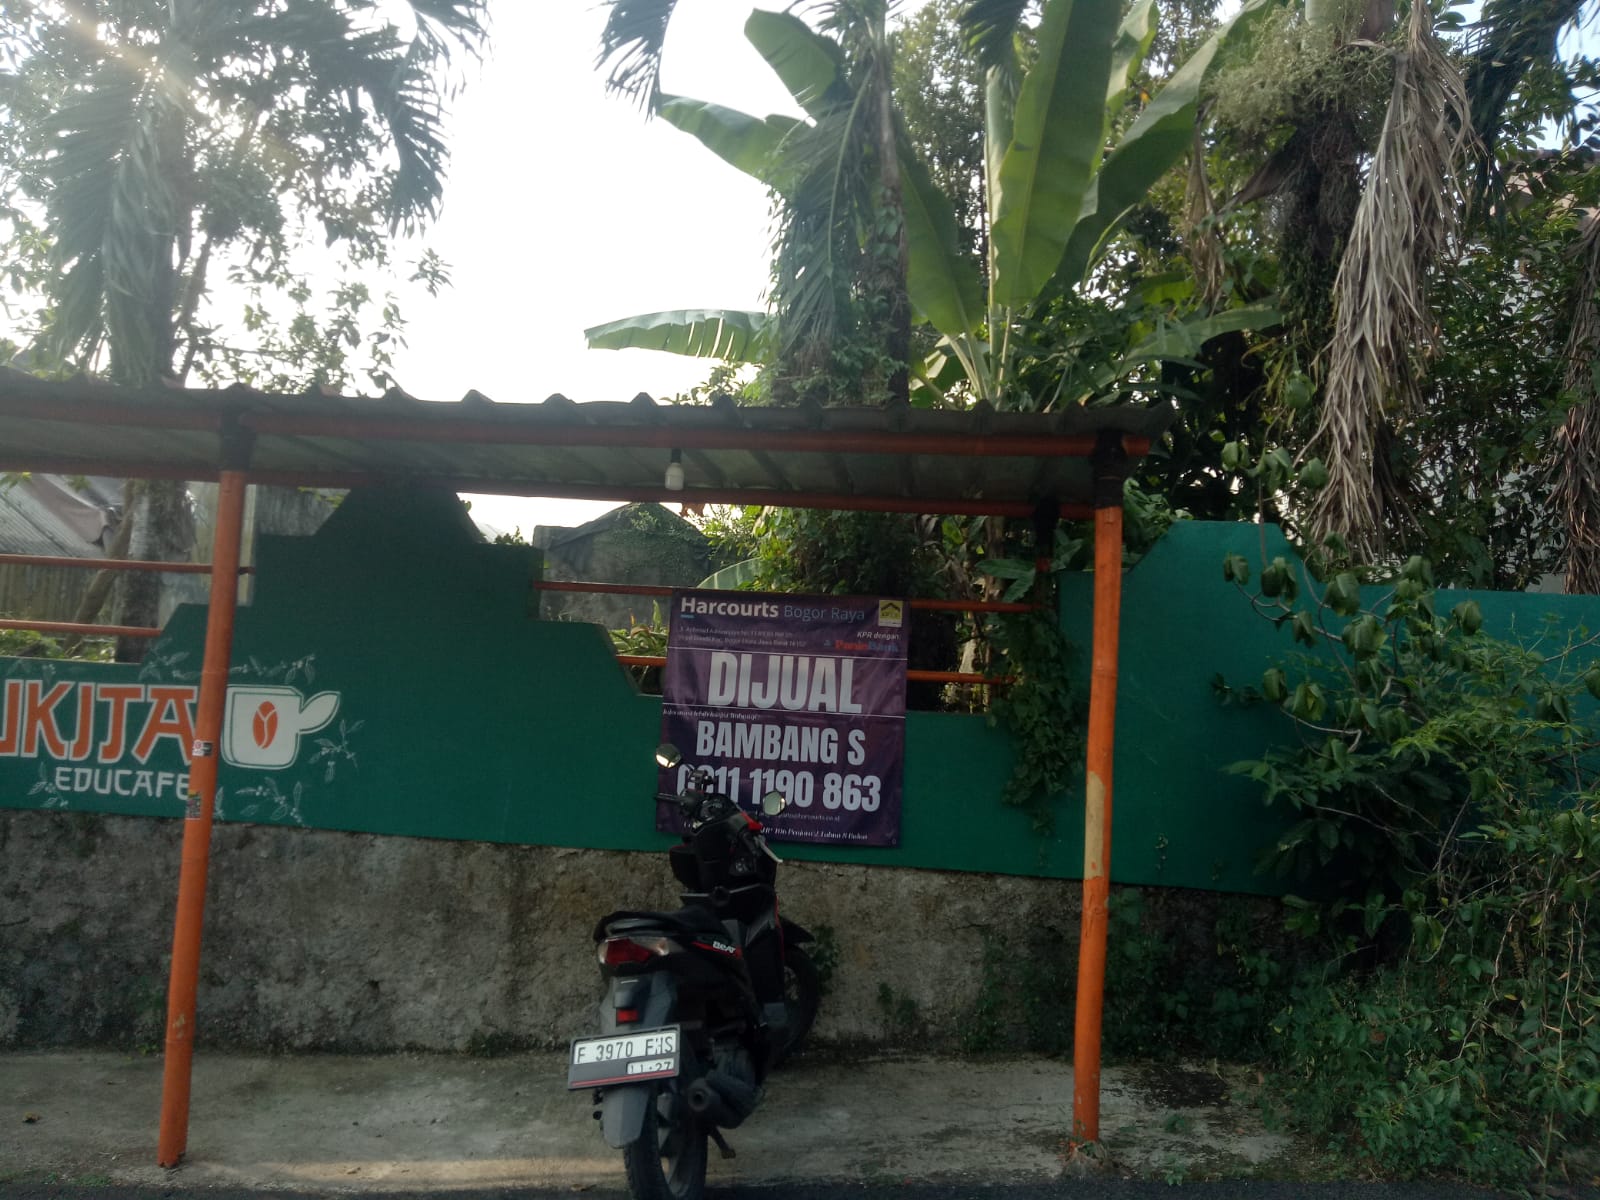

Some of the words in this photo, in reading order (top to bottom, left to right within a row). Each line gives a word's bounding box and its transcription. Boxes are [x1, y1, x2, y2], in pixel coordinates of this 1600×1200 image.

[681, 597, 779, 618] Harcourts
[784, 605, 826, 622] Bogor
[831, 607, 865, 624] Raya
[857, 631, 873, 640] KPR
[707, 651, 862, 714] DIJUAL
[696, 720, 839, 764] BAMBANG
[847, 729, 866, 766] S
[55, 766, 191, 801] EDUCAFE
[750, 767, 814, 808] 1190
[823, 772, 881, 812] 863
[577, 1046, 587, 1064] F
[595, 1041, 634, 1061] 3970
